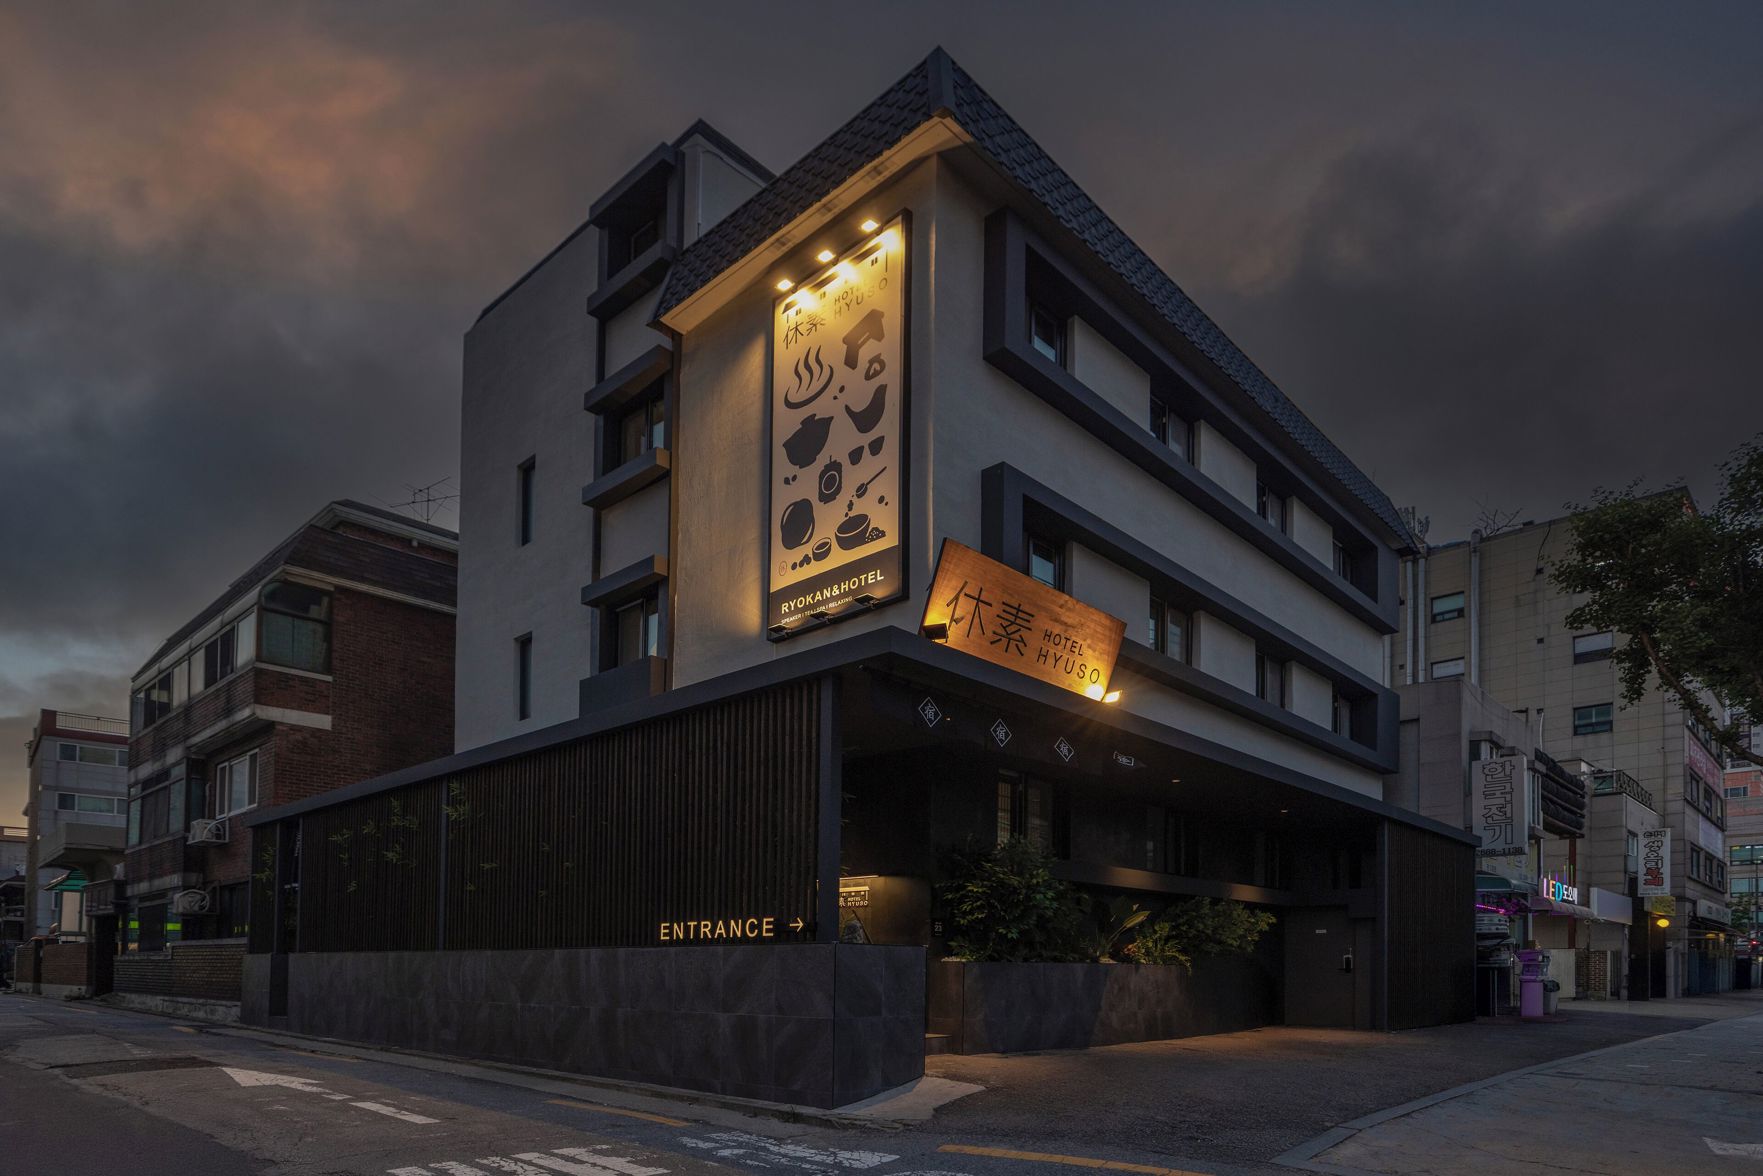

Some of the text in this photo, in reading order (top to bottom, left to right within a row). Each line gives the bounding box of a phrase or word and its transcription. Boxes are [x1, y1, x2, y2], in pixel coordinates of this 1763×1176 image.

[834, 277, 888, 319] HYUSO
[781, 569, 884, 614] RYOKAN&HOTEL
[946, 580, 1035, 656] 休素
[1043, 628, 1084, 656] HOTEL
[1036, 647, 1100, 684] HYUSO
[1482, 760, 1515, 845] 한국전기
[660, 917, 775, 940] ENTRANCE
